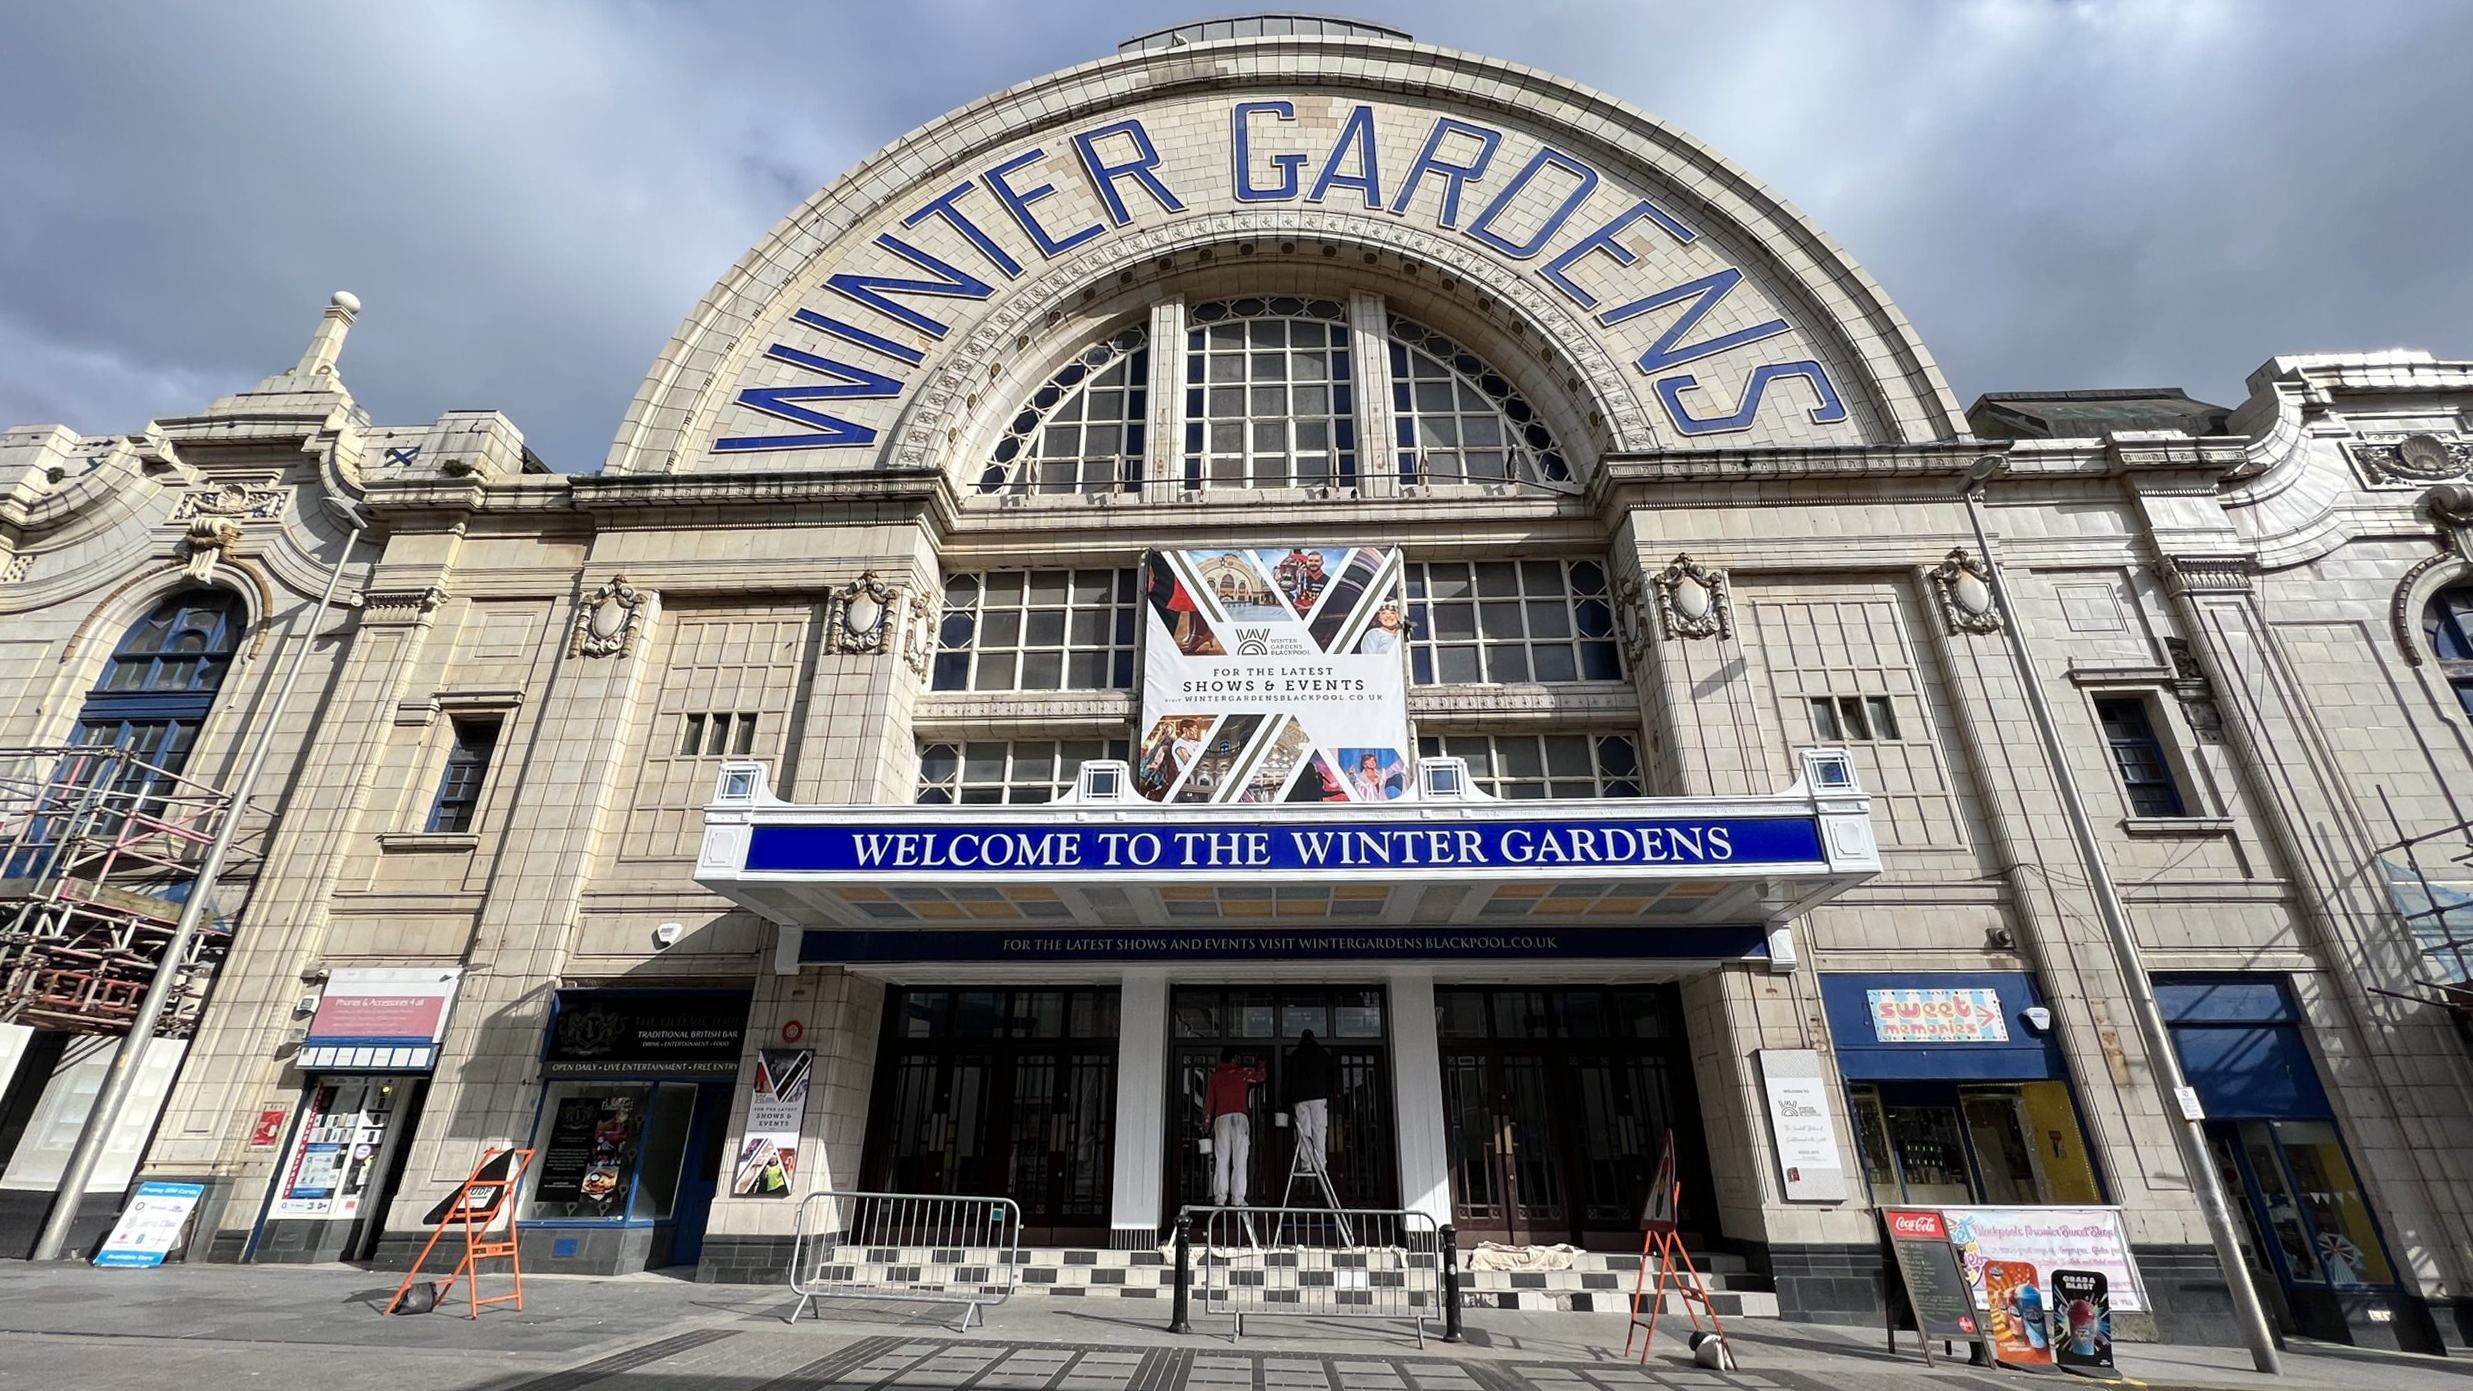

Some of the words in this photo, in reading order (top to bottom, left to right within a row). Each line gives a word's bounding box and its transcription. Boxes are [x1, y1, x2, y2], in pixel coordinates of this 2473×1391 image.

[710, 118, 1189, 454] WINTER
[1231, 101, 1848, 436] GARDENS
[1213, 668, 1240, 677] FOR
[1247, 668, 1275, 676] THE
[1281, 667, 1333, 676] LATEST
[1183, 680, 1255, 692] SHOWS
[1264, 680, 1275, 692] &
[1285, 679, 1365, 691] EVENTS
[852, 833, 1082, 867] WELCOME
[1098, 832, 1162, 866] TO
[1174, 832, 1271, 866] THE
[1290, 830, 1489, 865] WINTER
[1500, 827, 1733, 863] GARDENS
[1003, 939, 1030, 951] FOR
[1034, 939, 1062, 951] THE
[1066, 939, 1114, 951] LATEST
[1116, 938, 1167, 951] SHOWS
[1170, 938, 1202, 950] AND
[1204, 938, 1256, 950] EVENTS
[1258, 938, 1295, 950] VISIT
[335, 998, 361, 1007] Phones
[1878, 996, 1972, 1019] sweet
[635, 1016, 656, 1027] THE
[660, 1015, 686, 1027] OLD
[1883, 1019, 1978, 1036] memories
[637, 1030, 689, 1039] TRADITIONAL
[690, 1030, 721, 1039] BRITISH
[722, 1030, 738, 1038] BAR
[664, 1040, 709, 1048] ENTERTAINMENT
[552, 1063, 574, 1072] OPEN
[575, 1063, 597, 1071] DAILY
[603, 1063, 621, 1071] LIVE
[621, 1063, 687, 1071] ENTERTAINMENT
[693, 1063, 712, 1071] FREE
[712, 1063, 739, 1071] ENTRY
[2065, 1283, 2094, 1291] BLAST
